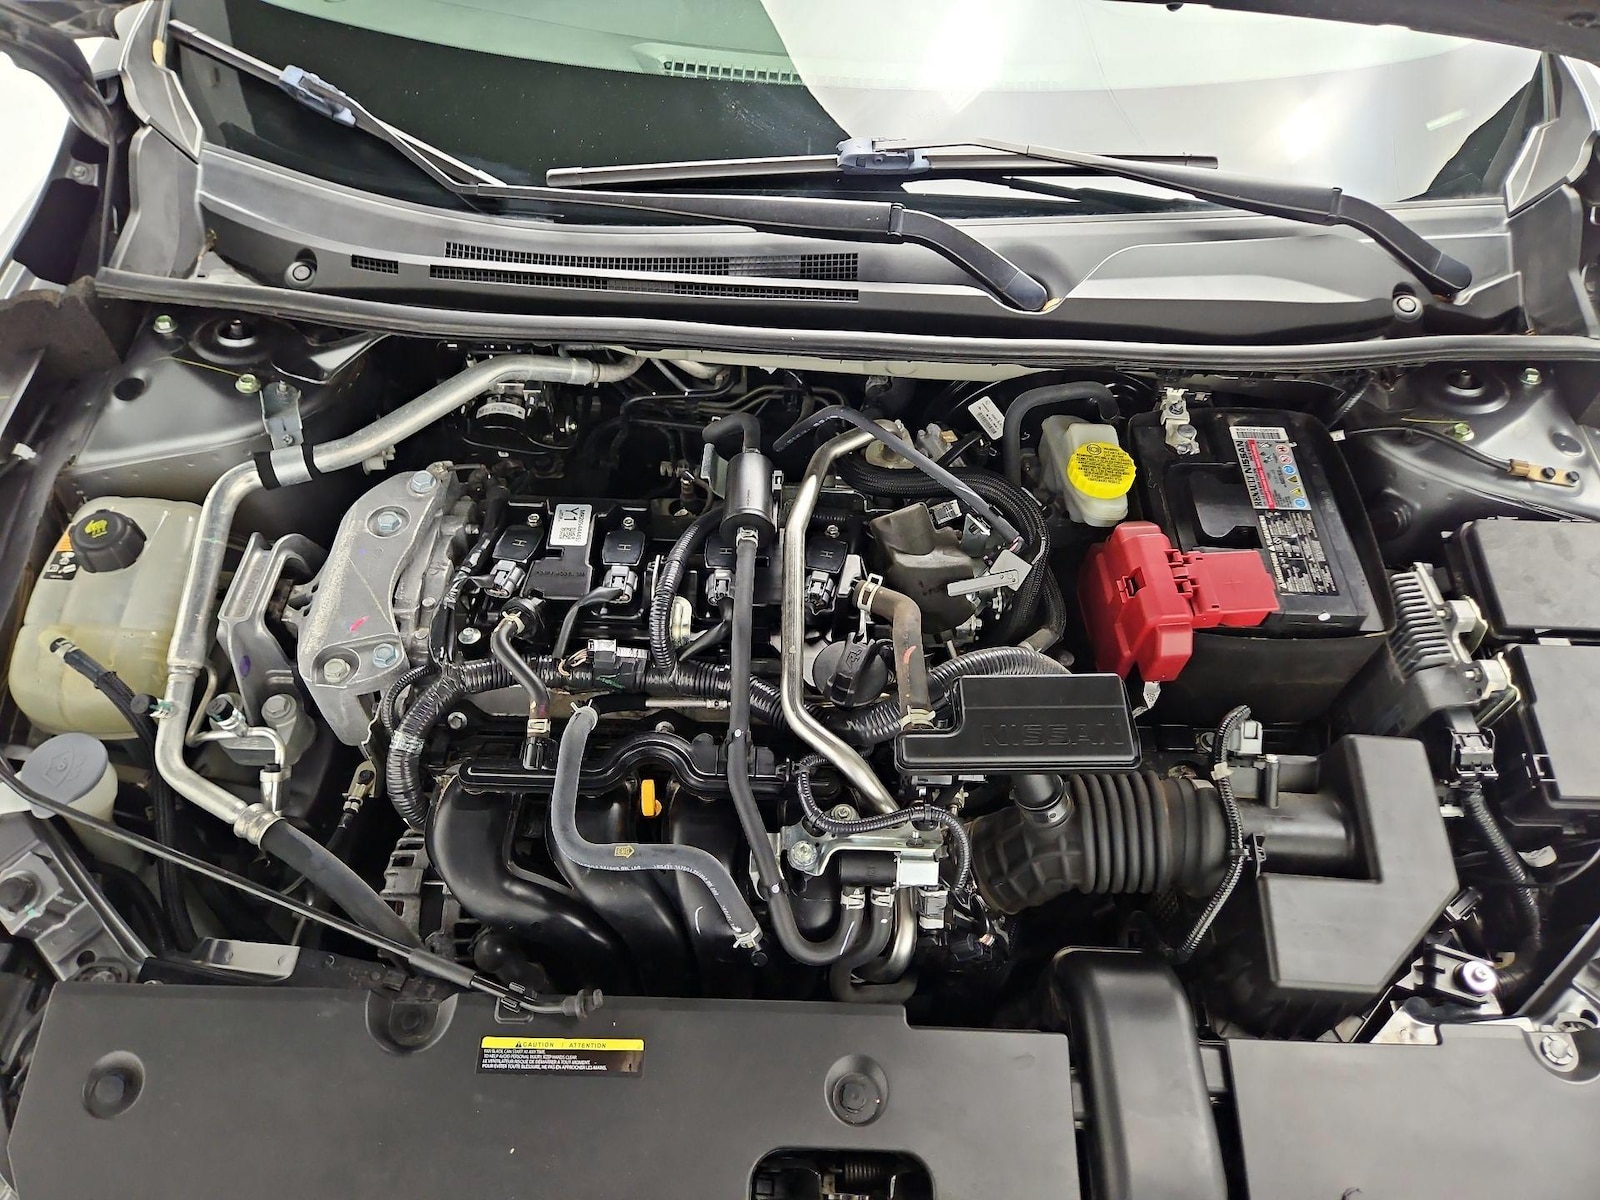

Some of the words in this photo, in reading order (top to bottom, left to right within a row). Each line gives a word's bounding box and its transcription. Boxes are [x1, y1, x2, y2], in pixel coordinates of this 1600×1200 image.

[1235, 440, 1253, 473] NISSAN
[1247, 475, 1263, 506] RENAULT
[564, 507, 579, 521] Y1
[983, 723, 1124, 746] NISSAN
